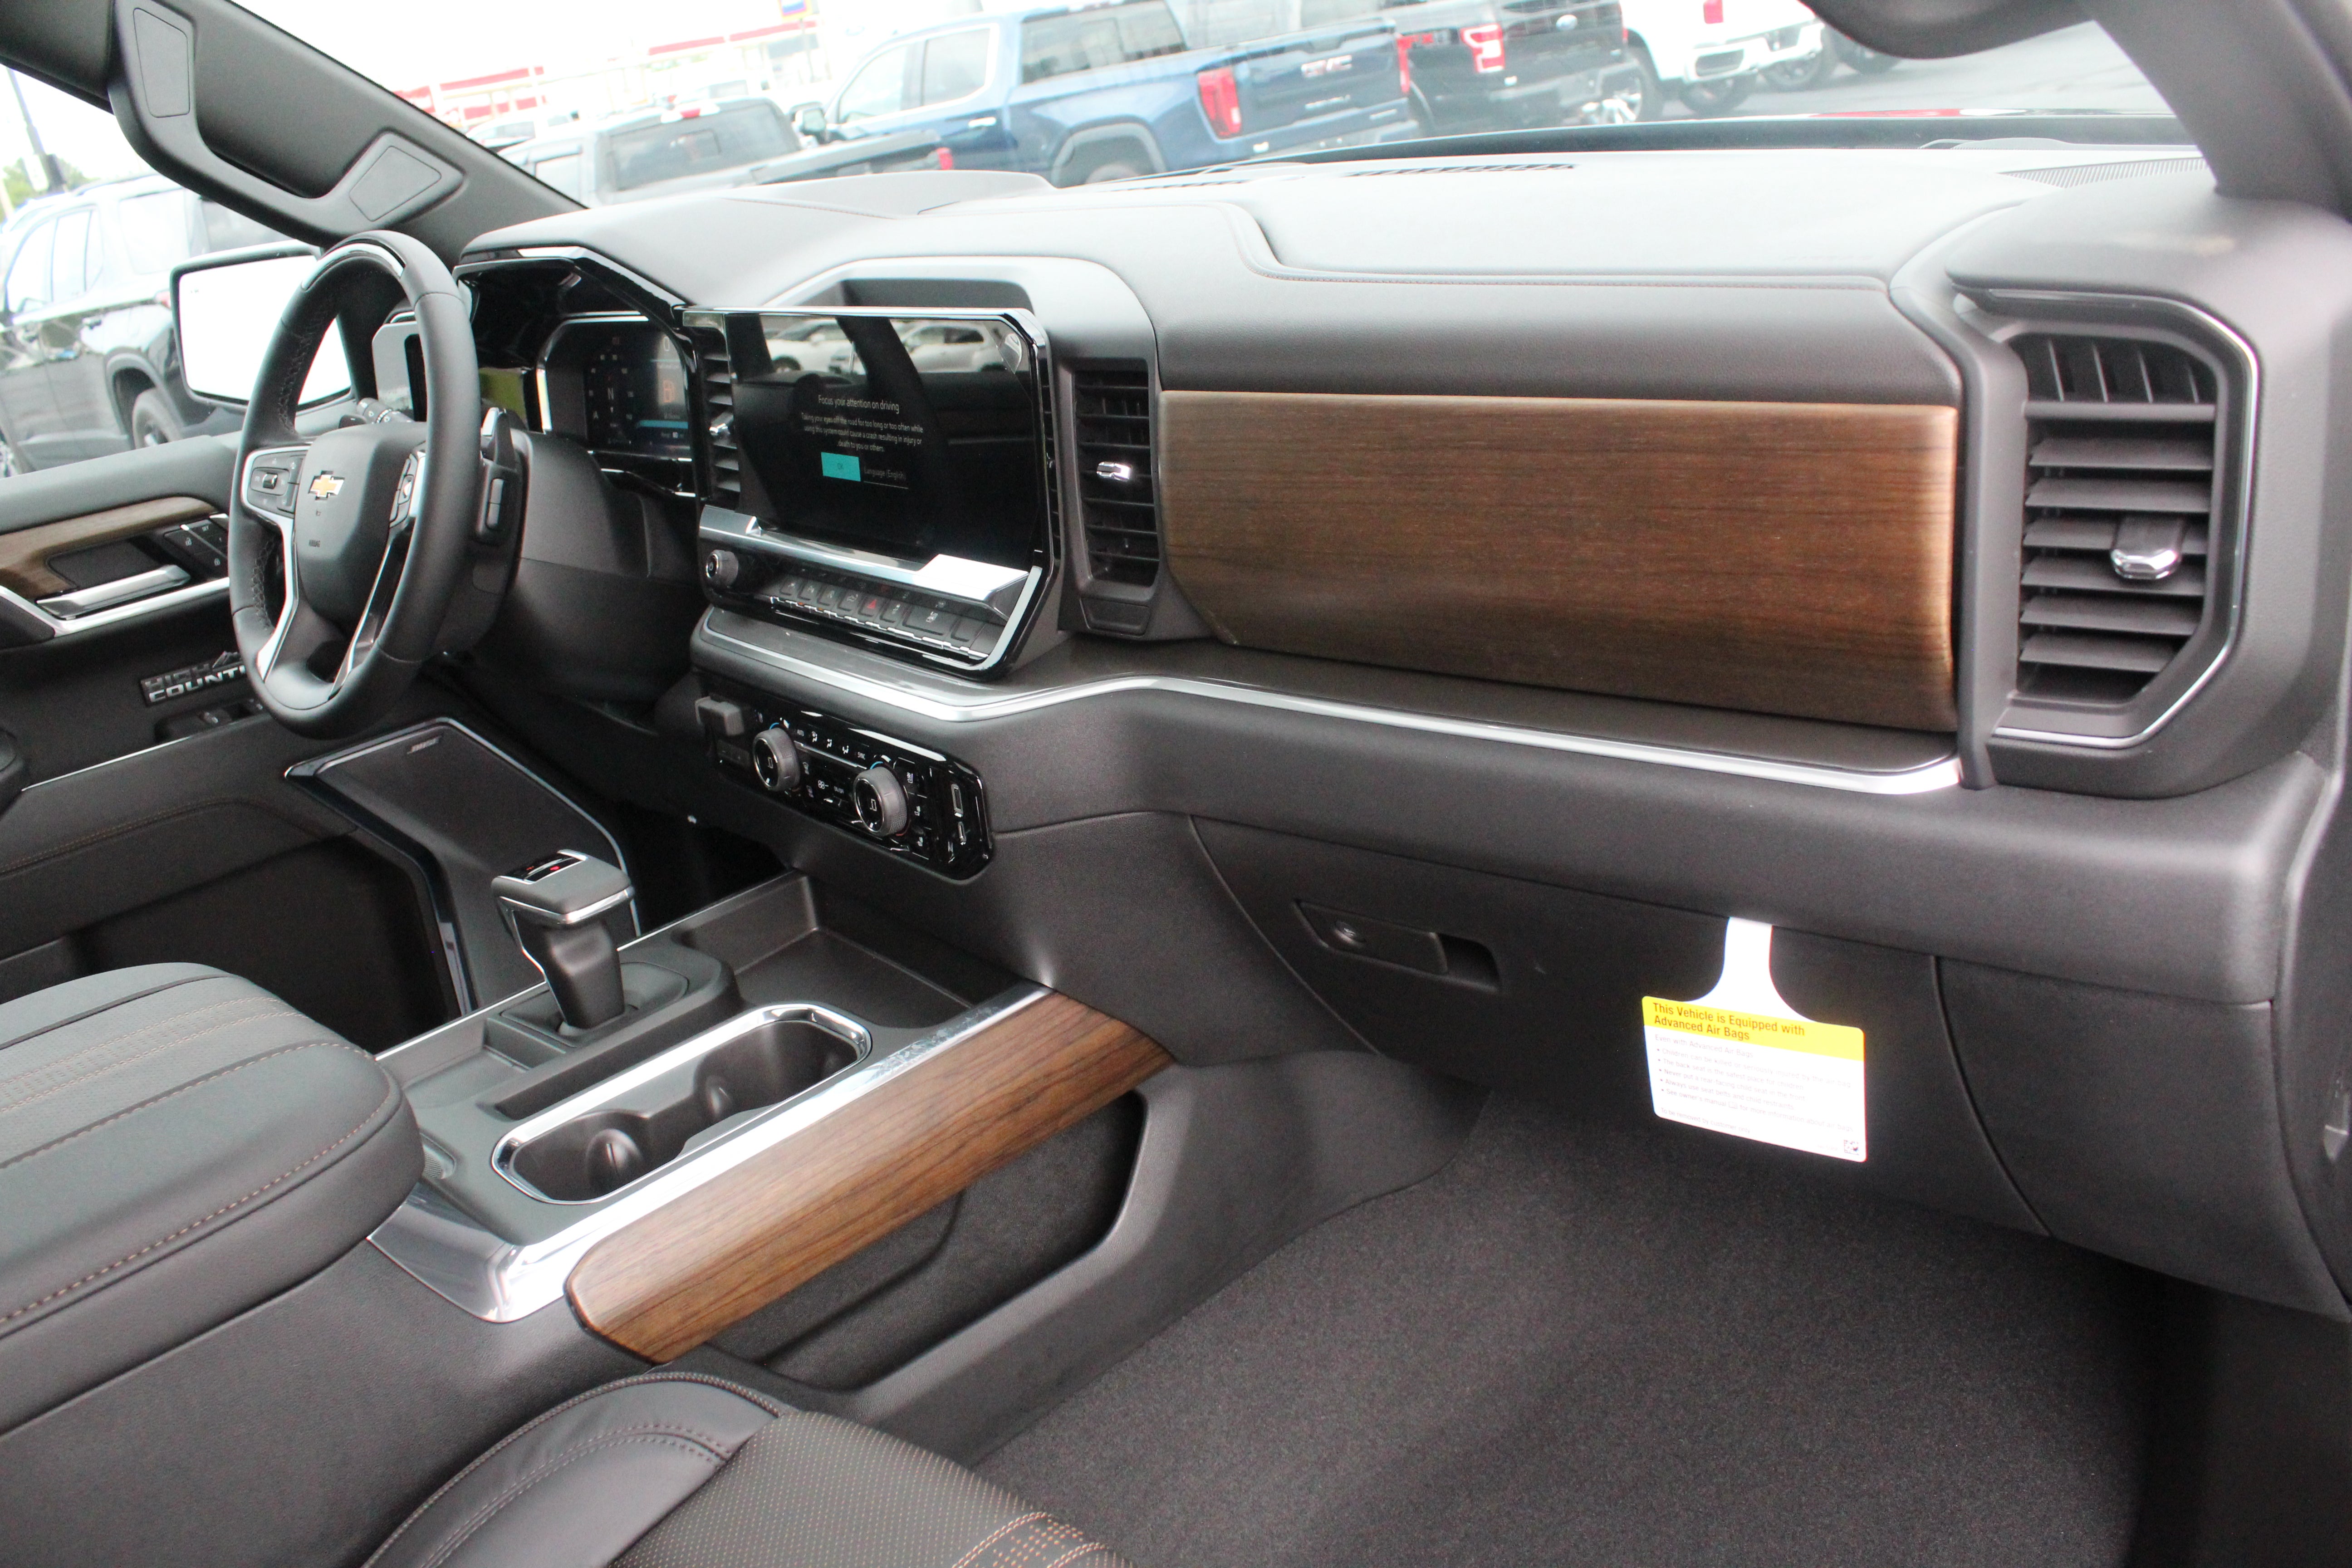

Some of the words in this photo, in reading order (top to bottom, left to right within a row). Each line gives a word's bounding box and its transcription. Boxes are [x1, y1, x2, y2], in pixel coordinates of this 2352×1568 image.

[818, 395, 833, 405] Focus
[834, 398, 845, 408] your
[847, 398, 871, 408] attention
[880, 399, 899, 414] driving
[802, 412, 814, 422] Taking
[873, 420, 883, 430] long
[898, 422, 910, 431] often
[911, 425, 923, 433] while
[804, 426, 814, 434] using
[878, 433, 897, 444] resulting
[903, 436, 916, 446] injury
[864, 466, 885, 478] Language
[887, 470, 906, 481] (English)
[145, 664, 210, 690] HIGH
[1653, 1002, 1673, 1014] This
[1677, 1007, 1713, 1021] Vehicle
[1717, 1013, 1725, 1023] is
[1729, 1015, 1777, 1031] Equipped
[1782, 1025, 1804, 1034] with
[1655, 1015, 1702, 1031] Advanced
[1706, 1024, 1720, 1034] Air
[1724, 1027, 1749, 1040] Bags
[1690, 1040, 1722, 1052] Advanced
[1736, 1049, 1753, 1058] Bags
[1662, 1048, 1688, 1058] Children
[1743, 1064, 1773, 1074] seriously
[1665, 1078, 1686, 1088] Always
[1700, 1077, 1735, 1088] rear-facing
[1726, 1072, 1745, 1081] safest
[1679, 1093, 1702, 1101] owner's
[1704, 1098, 1726, 1106] manual
[1768, 1112, 1804, 1122] information
[1676, 1112, 1700, 1122] removed
[1710, 1121, 1736, 1129] customer
